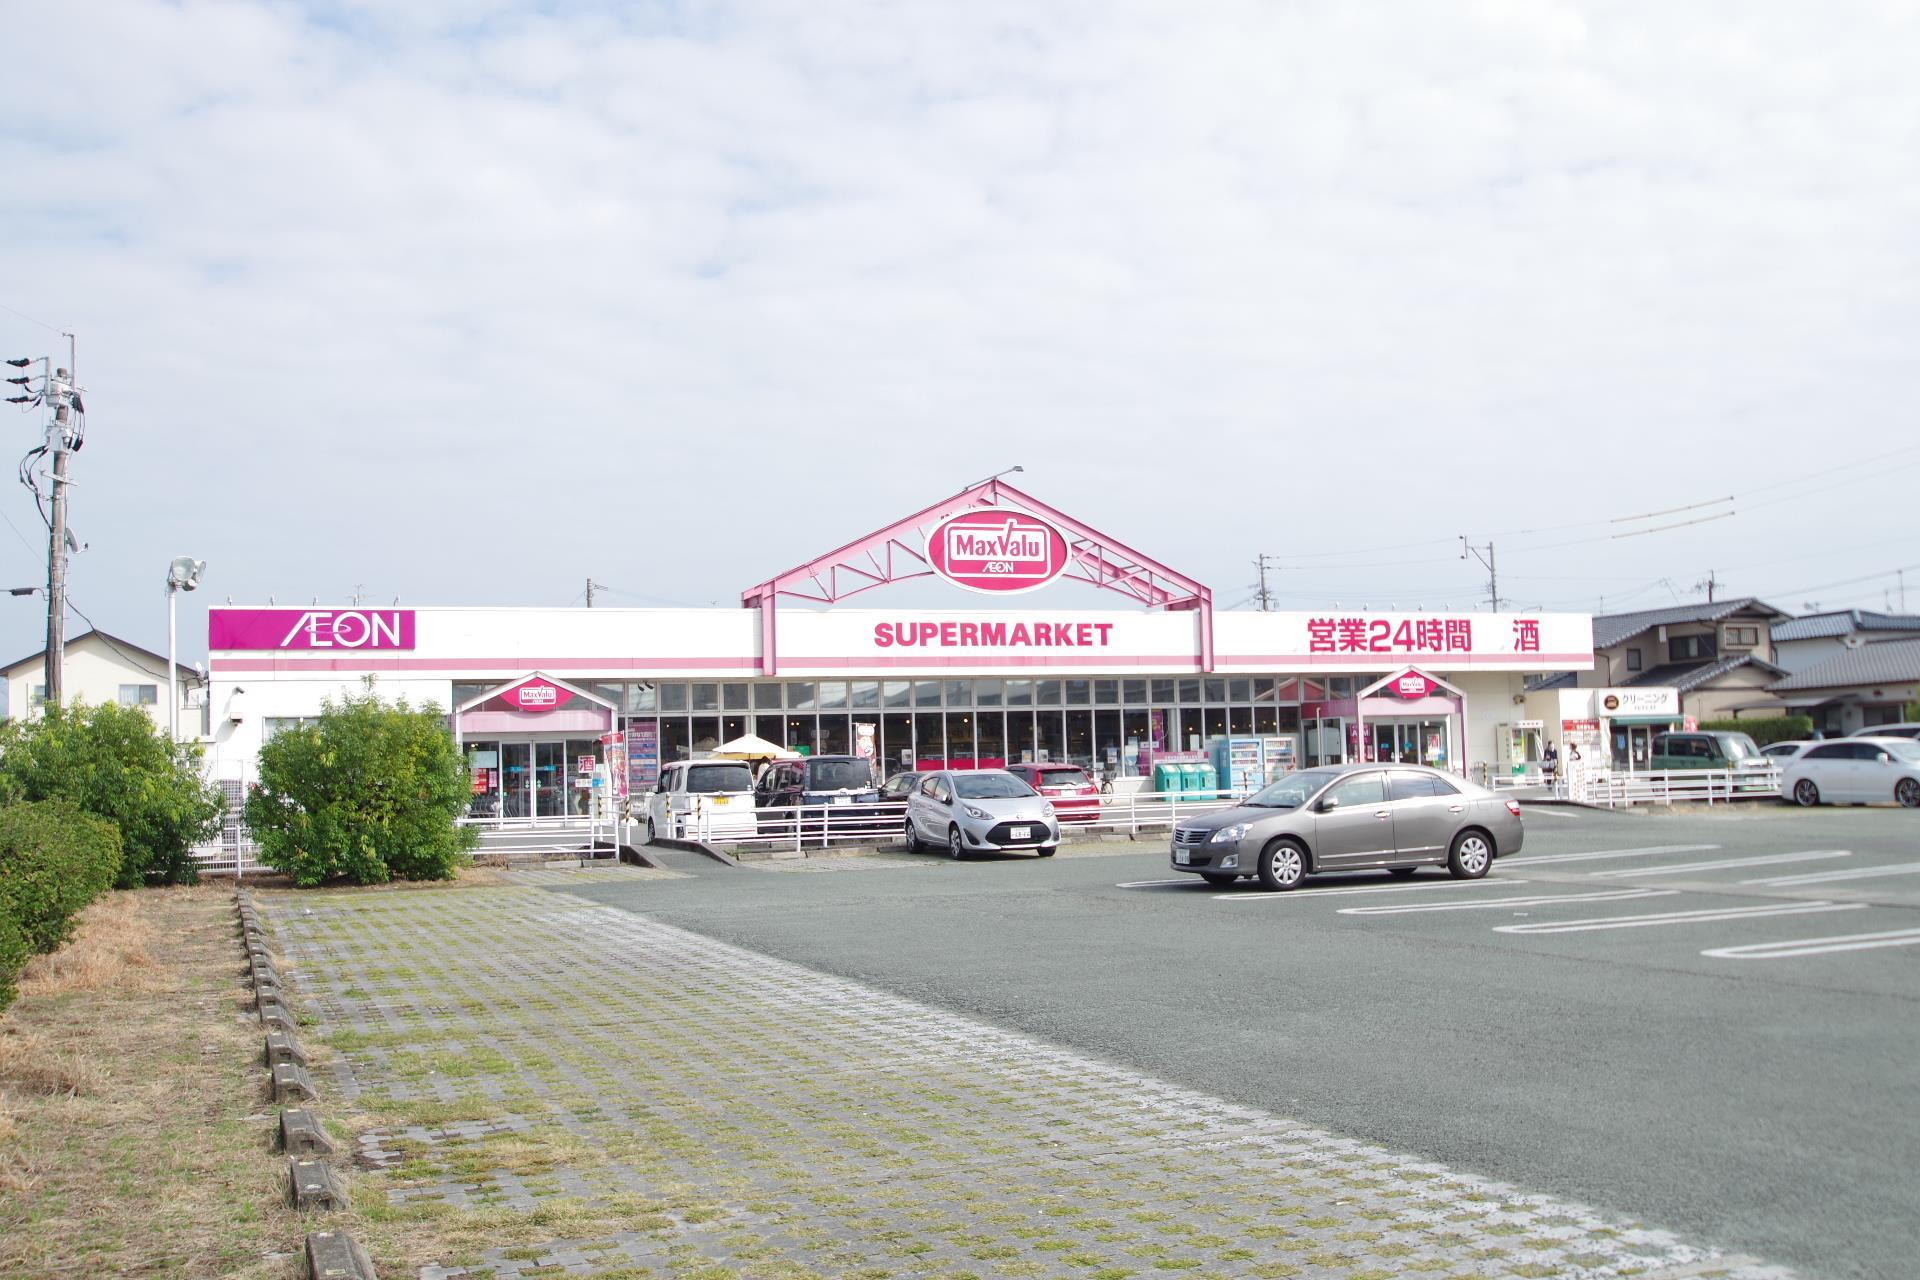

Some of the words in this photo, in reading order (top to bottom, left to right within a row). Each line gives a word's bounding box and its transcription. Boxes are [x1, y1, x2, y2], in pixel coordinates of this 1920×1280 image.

[956, 521, 1040, 557] MaxValu
[874, 622, 1113, 648] SUPERMARKET
[1307, 617, 1472, 653] 営業24時間
[1512, 619, 1540, 652] 酒
[523, 685, 552, 698] MaxValu
[1622, 692, 1669, 705] クリーニング
[1352, 729, 1369, 737] AM
[579, 756, 595, 772] 酒
